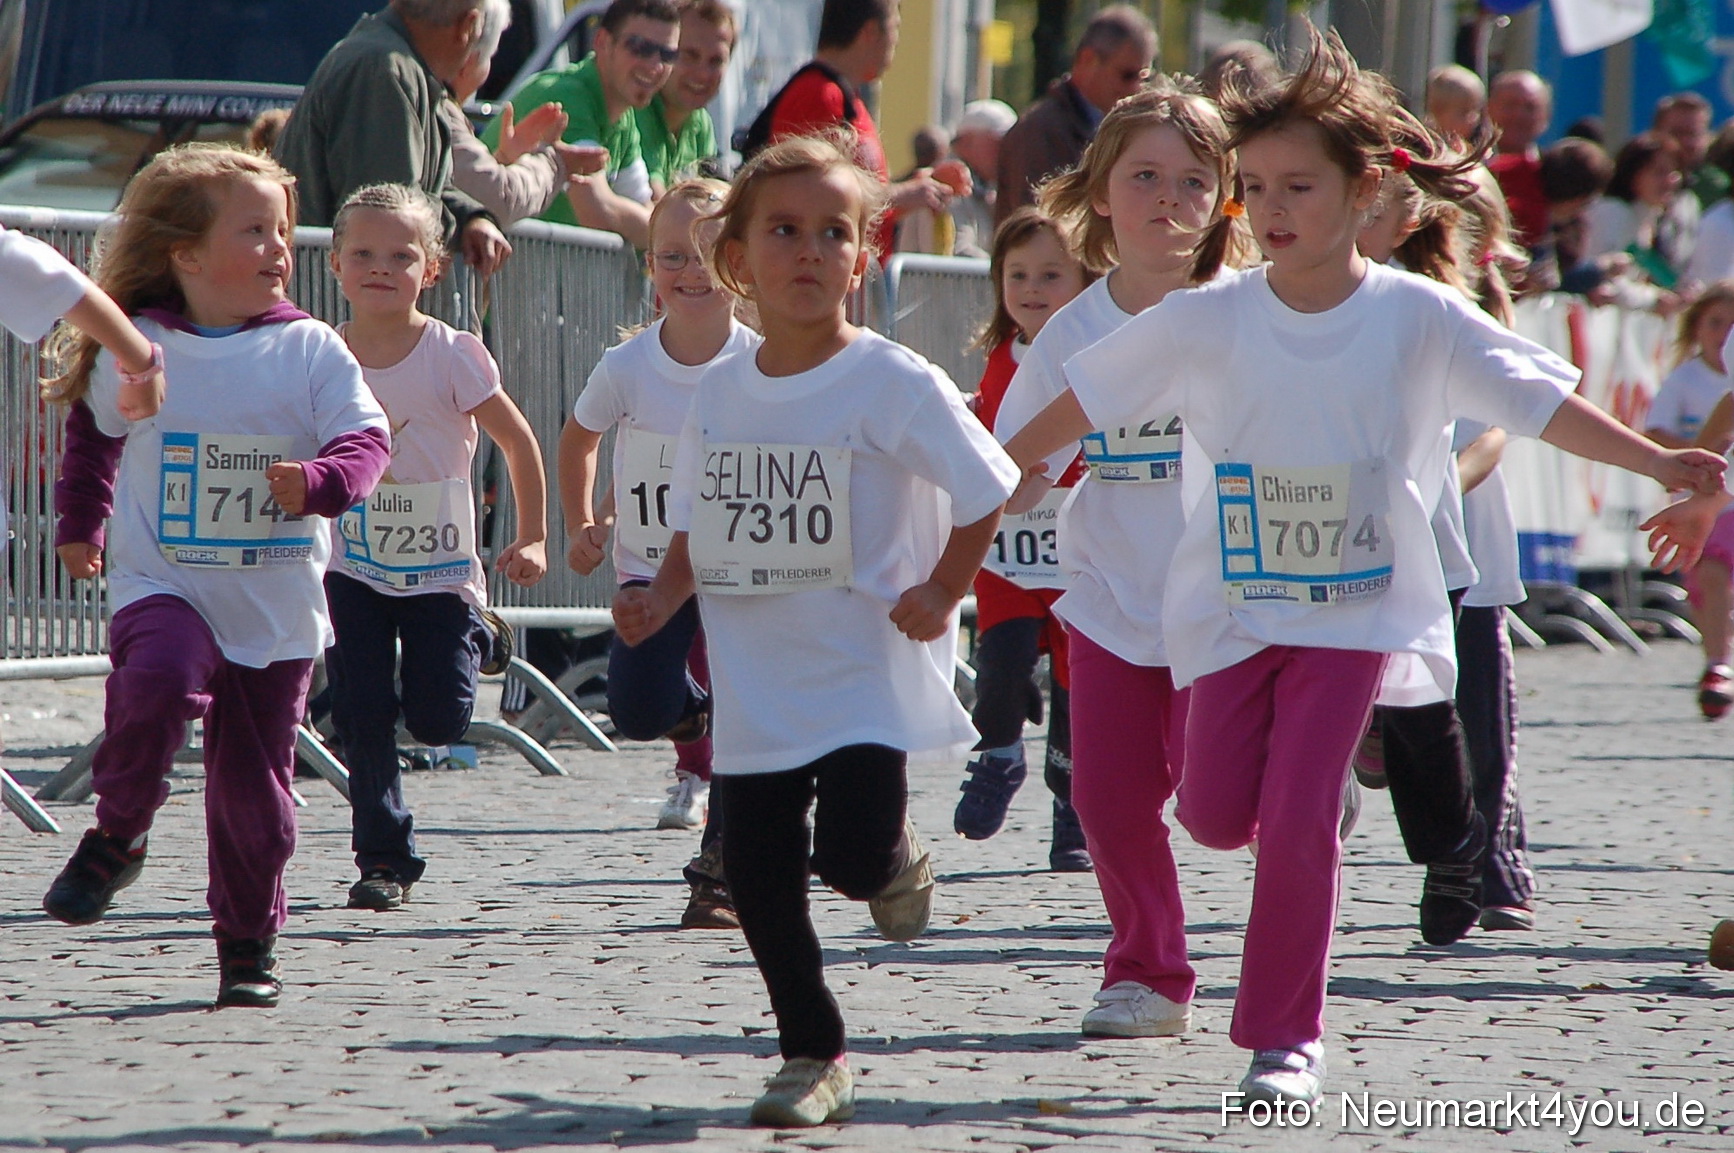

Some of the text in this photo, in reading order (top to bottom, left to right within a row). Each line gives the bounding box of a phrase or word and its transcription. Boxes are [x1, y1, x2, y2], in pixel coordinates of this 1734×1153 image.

[63, 93, 106, 113] DER
[105, 93, 166, 114] NEUE
[166, 94, 218, 117] MINI
[1262, 475, 1333, 503] Chiara
[371, 492, 413, 513] Julia
[726, 502, 833, 545] 7310
[374, 523, 460, 554] 7230
[1268, 514, 1381, 558] 7074
[258, 547, 313, 558] PFLEIDERER
[770, 567, 832, 579] PFLEIDERER
[1329, 575, 1392, 595] PFLEIDERER
